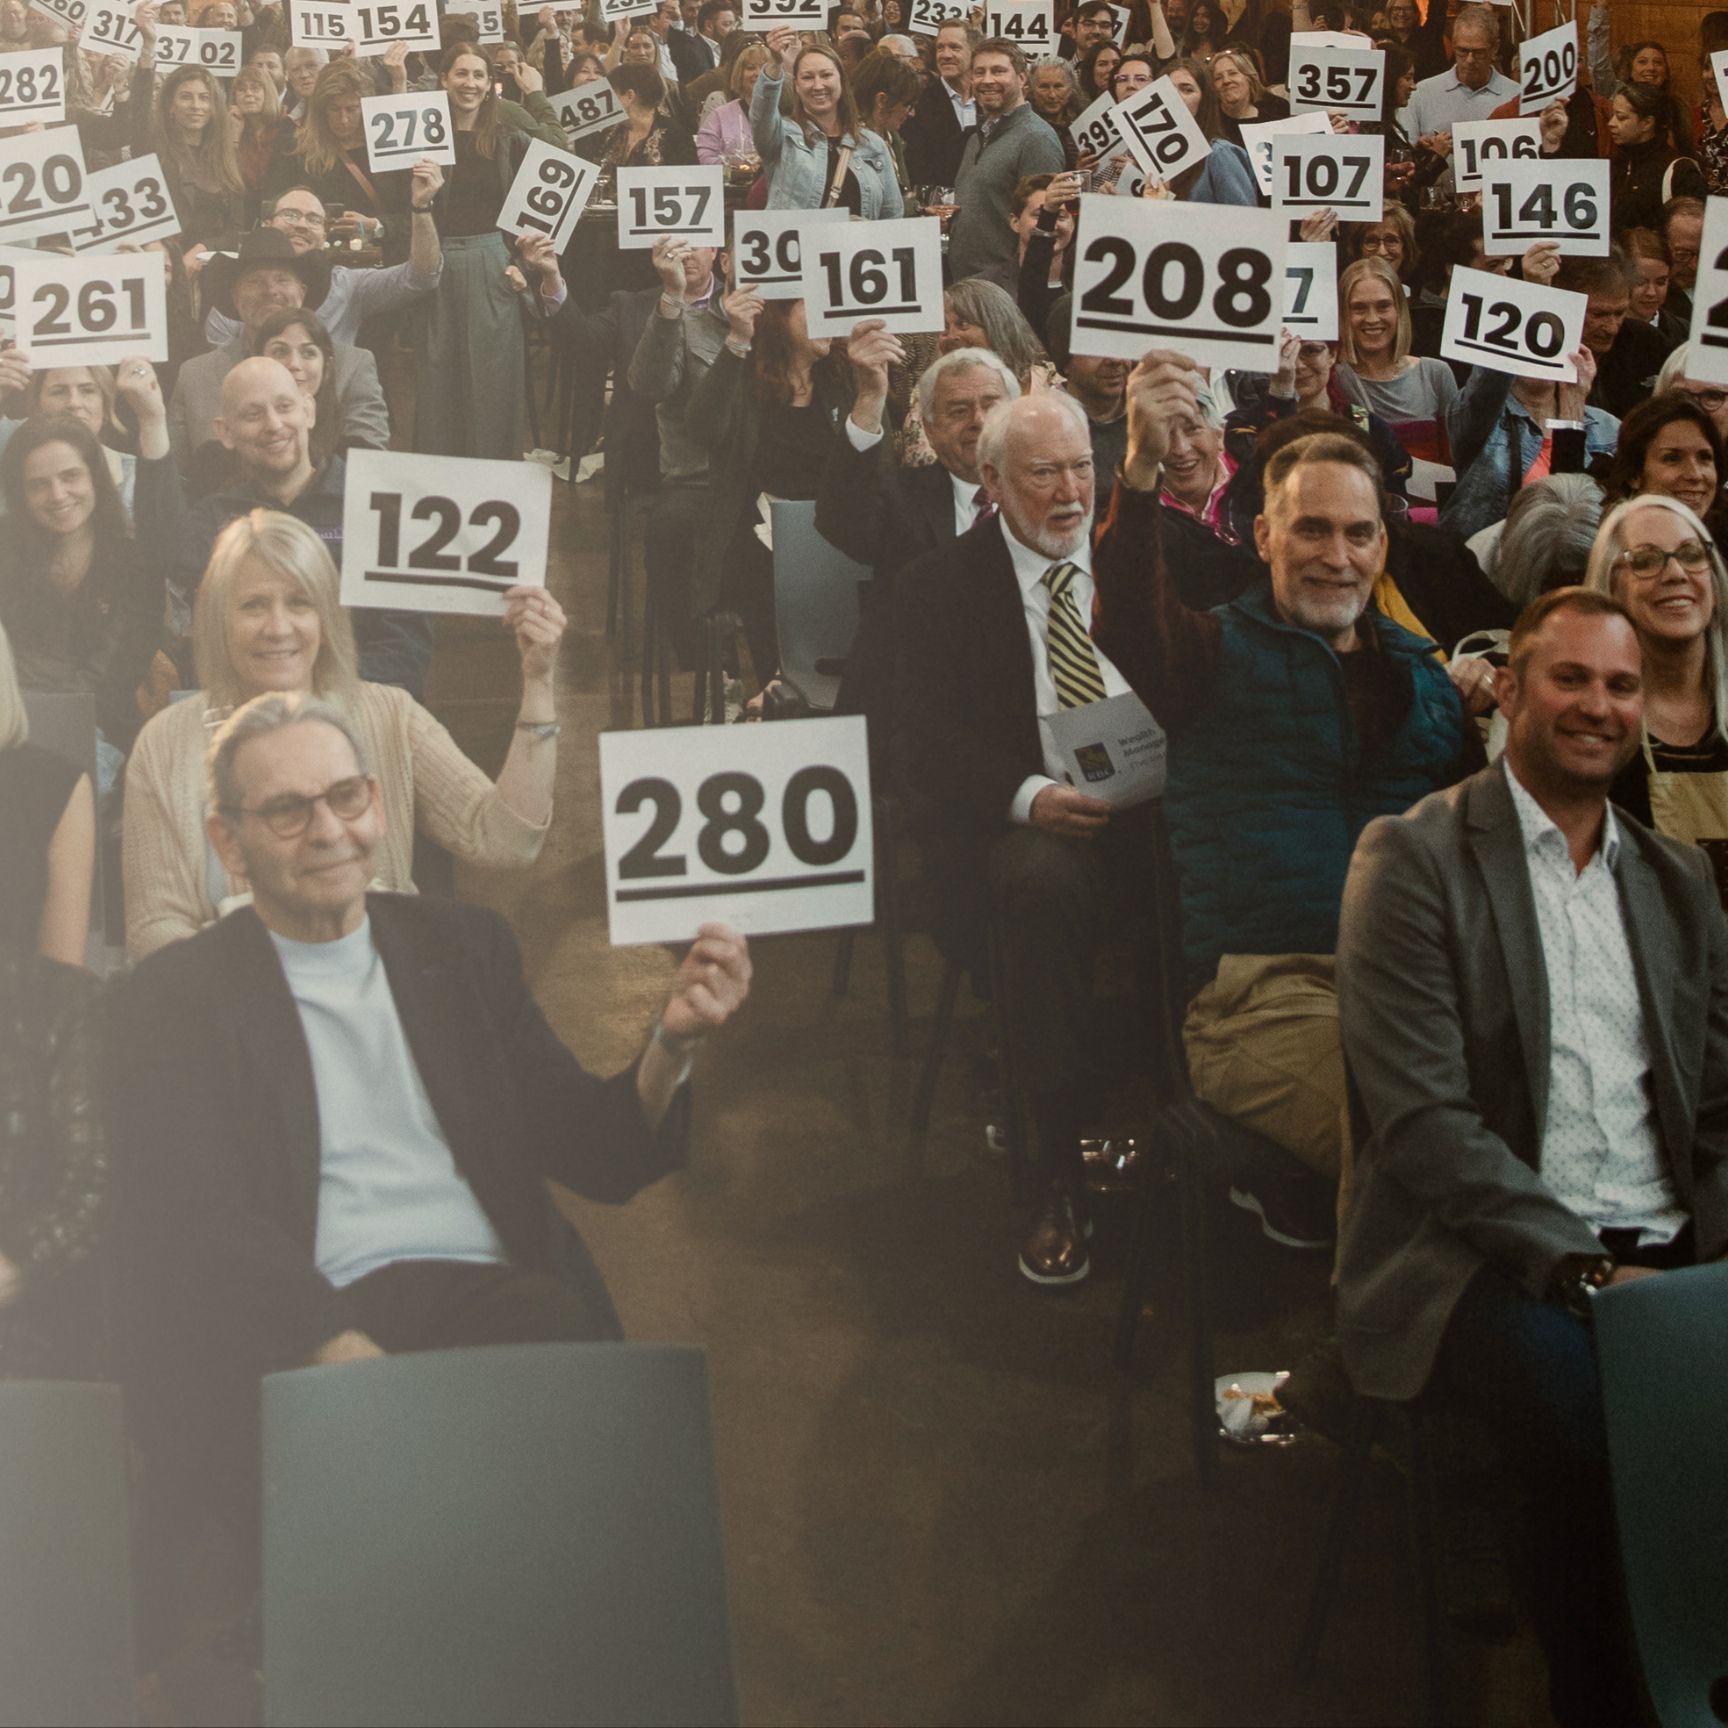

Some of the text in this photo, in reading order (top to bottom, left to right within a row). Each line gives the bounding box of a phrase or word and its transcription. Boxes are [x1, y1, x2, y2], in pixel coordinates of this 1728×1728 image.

[93, 10, 138, 44] 317
[301, 12, 345, 36] 115
[358, 4, 430, 39] 154
[991, 13, 1048, 39] 144
[157, 36, 191, 61] 37
[200, 42, 235, 64] 02
[1524, 42, 1574, 92] 200
[1298, 64, 1378, 102] 357
[372, 108, 446, 149] 278
[560, 90, 614, 129] 487
[1140, 93, 1188, 164] 170
[516, 158, 576, 234] 169
[1282, 154, 1370, 198] 107
[629, 186, 711, 228] 157
[1492, 182, 1596, 230] 146
[740, 230, 802, 276] 30
[820, 247, 916, 306] 161
[1081, 236, 1272, 327] 208
[32, 278, 145, 336] 261
[1460, 293, 1565, 358] 120
[369, 491, 521, 578] 122
[614, 764, 858, 880] 280
